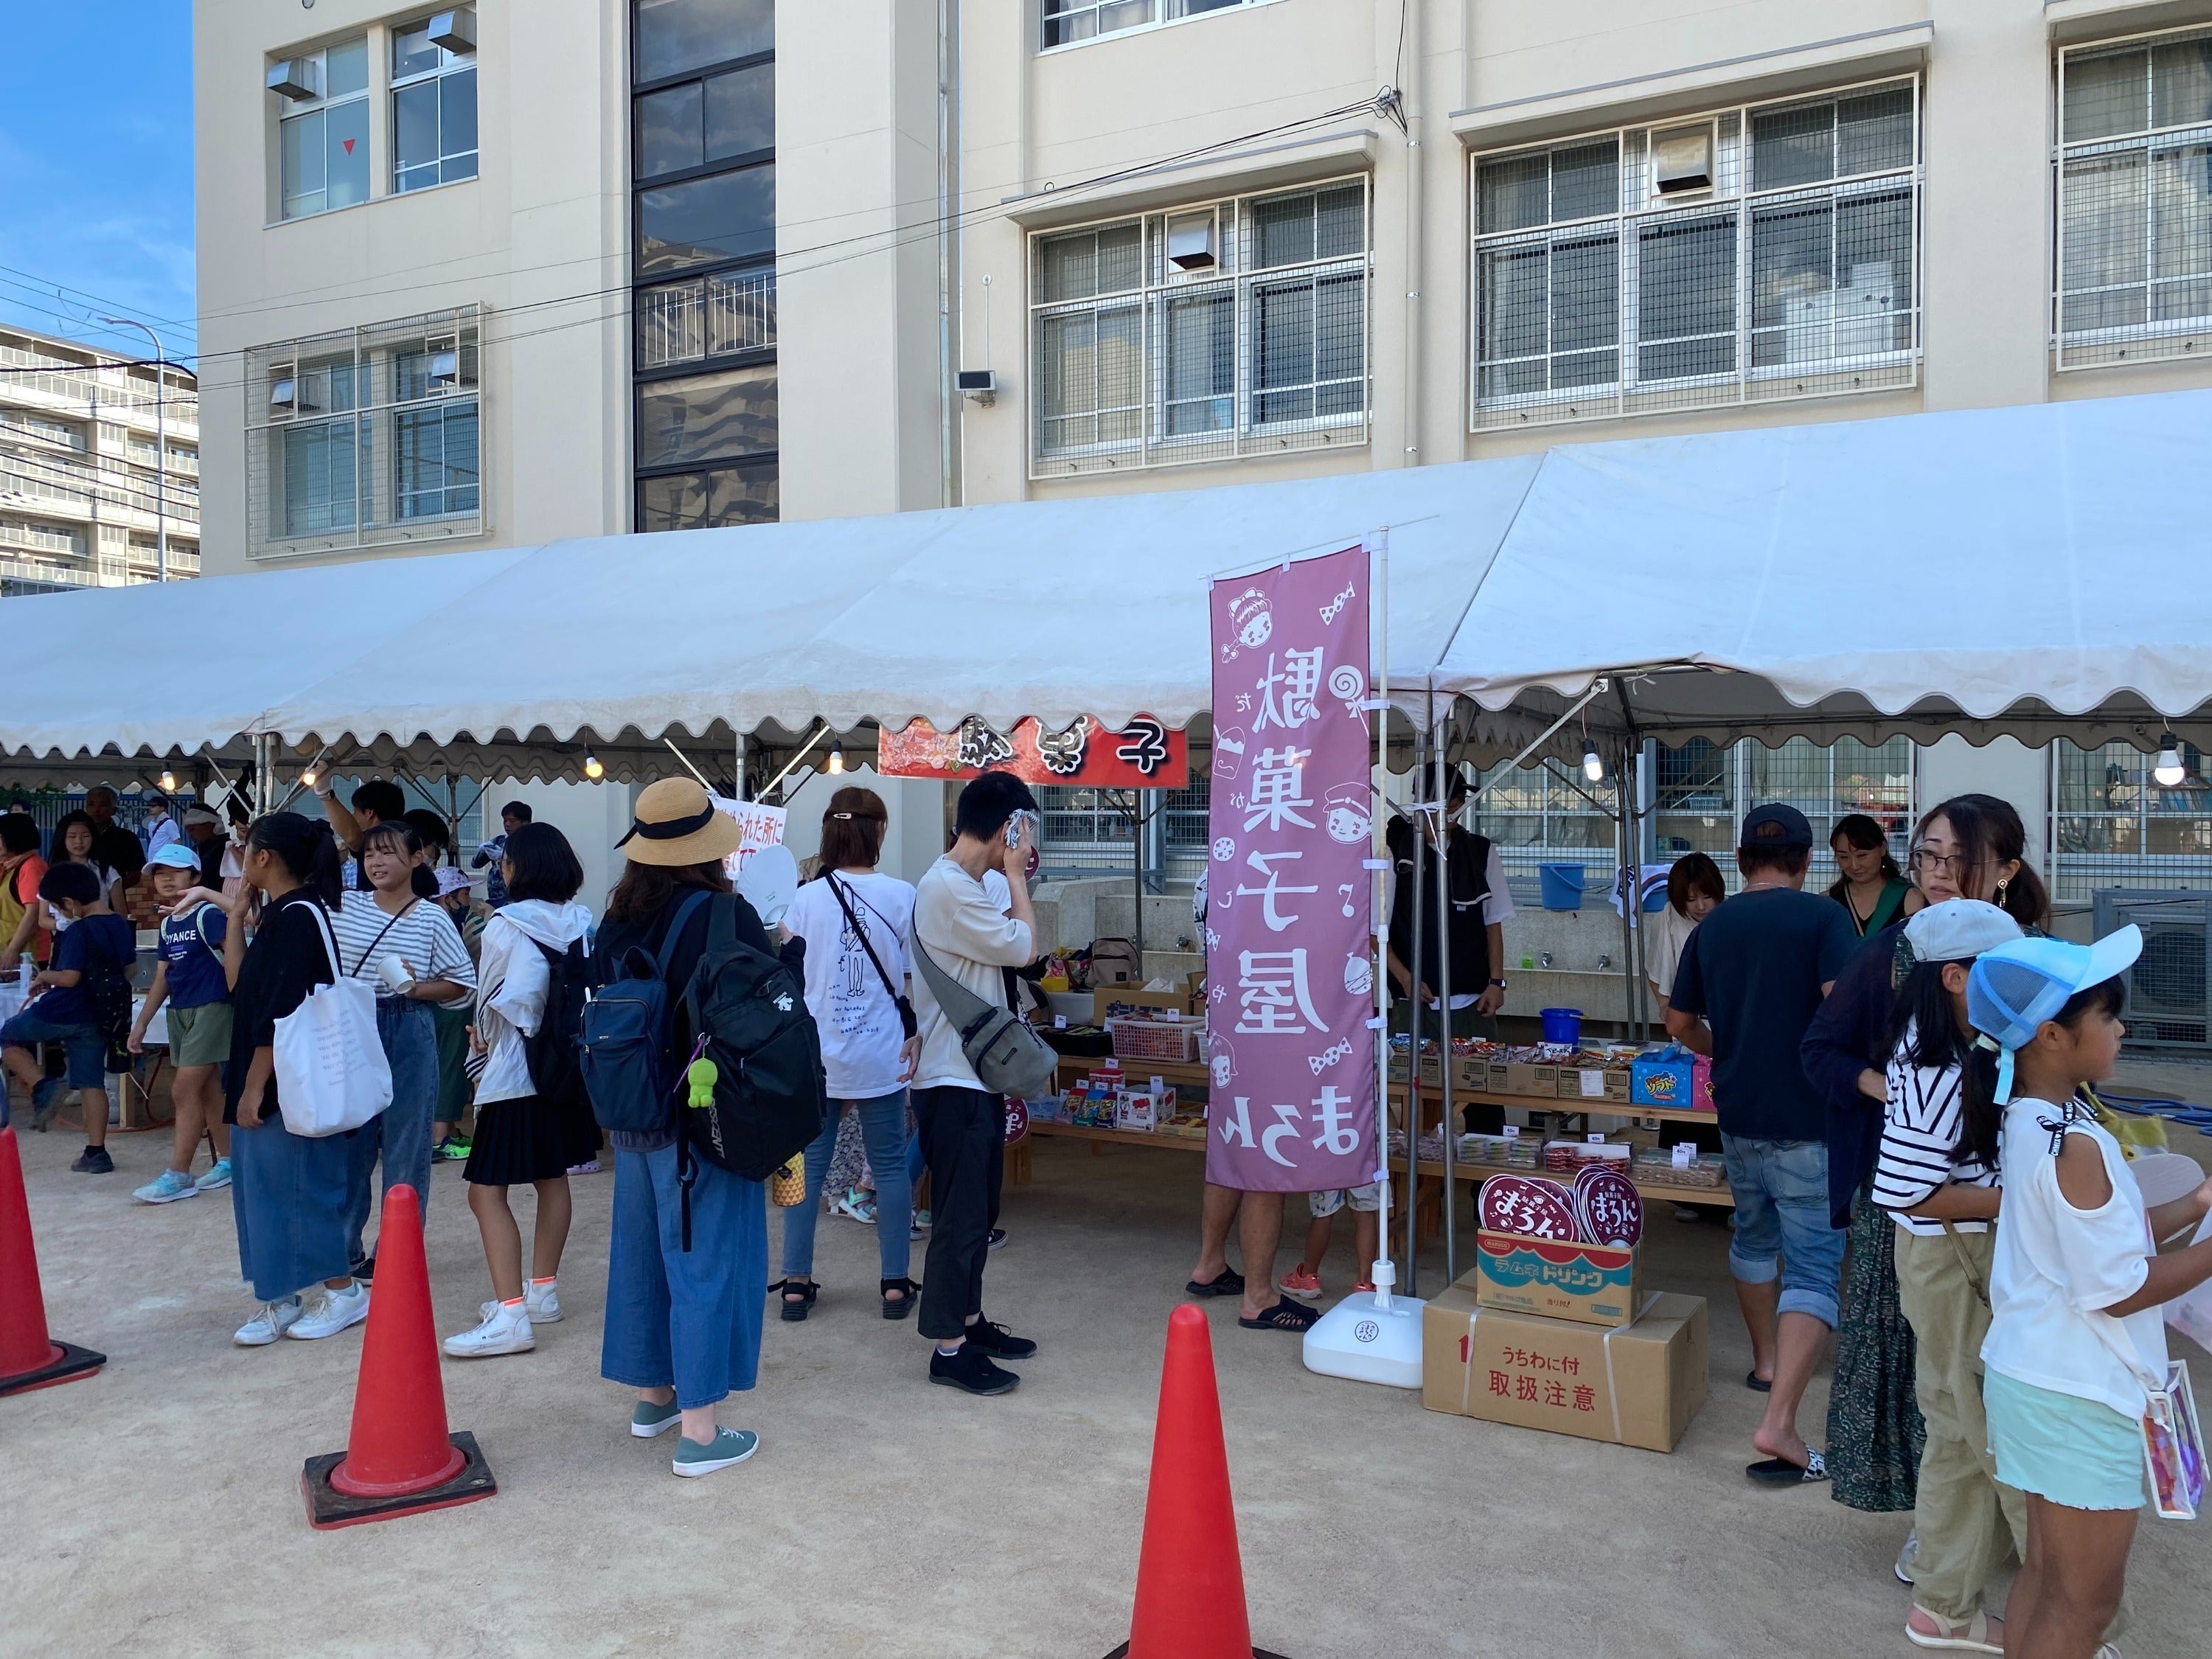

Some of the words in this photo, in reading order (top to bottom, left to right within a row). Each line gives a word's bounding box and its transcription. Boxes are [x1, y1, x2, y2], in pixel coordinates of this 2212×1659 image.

[1596, 1192, 1638, 1228] まろん
[1503, 1346, 1579, 1376] うちわに付
[1489, 1370, 1596, 1412] 取扱注意
